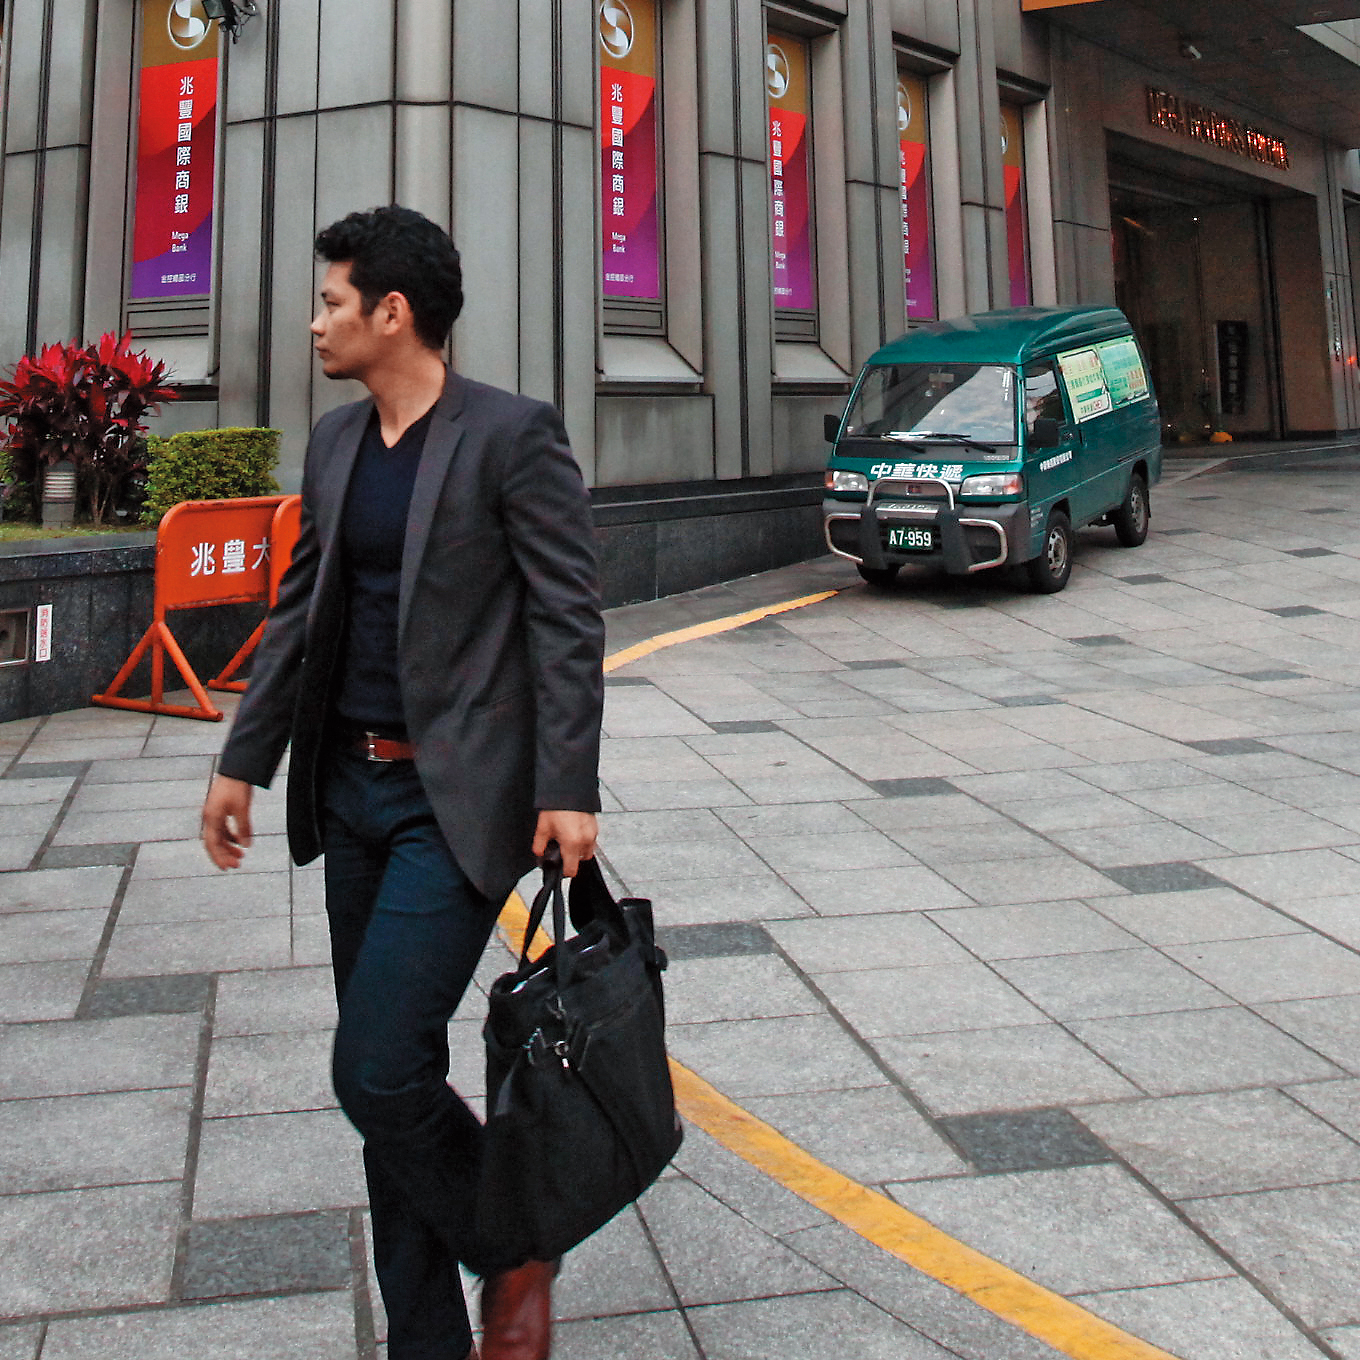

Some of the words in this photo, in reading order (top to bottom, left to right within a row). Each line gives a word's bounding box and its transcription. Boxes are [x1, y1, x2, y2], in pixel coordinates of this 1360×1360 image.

[173, 76, 195, 214] 兆豐國際商銀
[611, 83, 625, 217] 兆豐國際商銀
[870, 462, 964, 480] 中華快遞
[889, 529, 932, 547] A7-959
